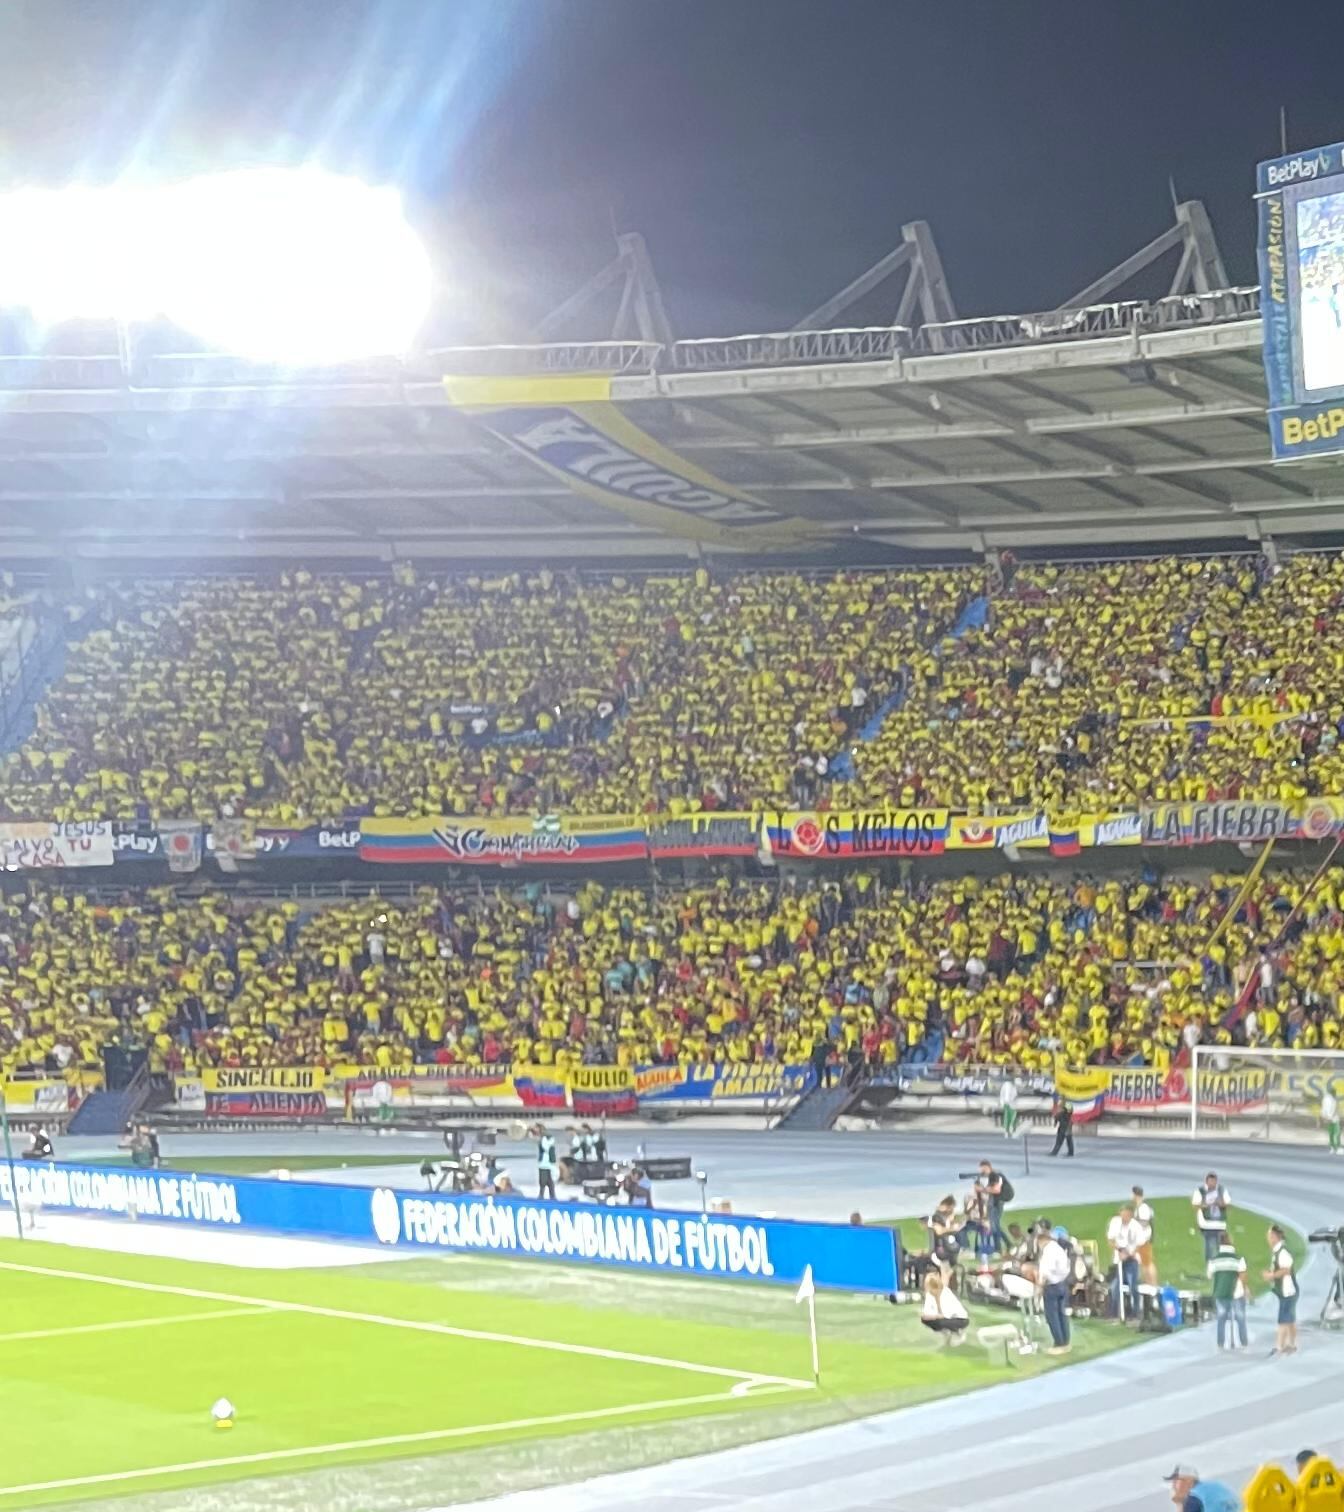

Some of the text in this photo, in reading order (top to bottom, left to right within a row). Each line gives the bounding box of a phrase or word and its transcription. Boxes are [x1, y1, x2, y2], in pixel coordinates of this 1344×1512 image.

[1267, 160, 1320, 185] BetPlay
[851, 811, 936, 853] MELOS
[1111, 1072, 1163, 1101] FIEBRE
[159, 1178, 182, 1218] DE
[403, 1194, 775, 1276] FEDERACIÓN COLOMBIANA DE FÚTBOL
